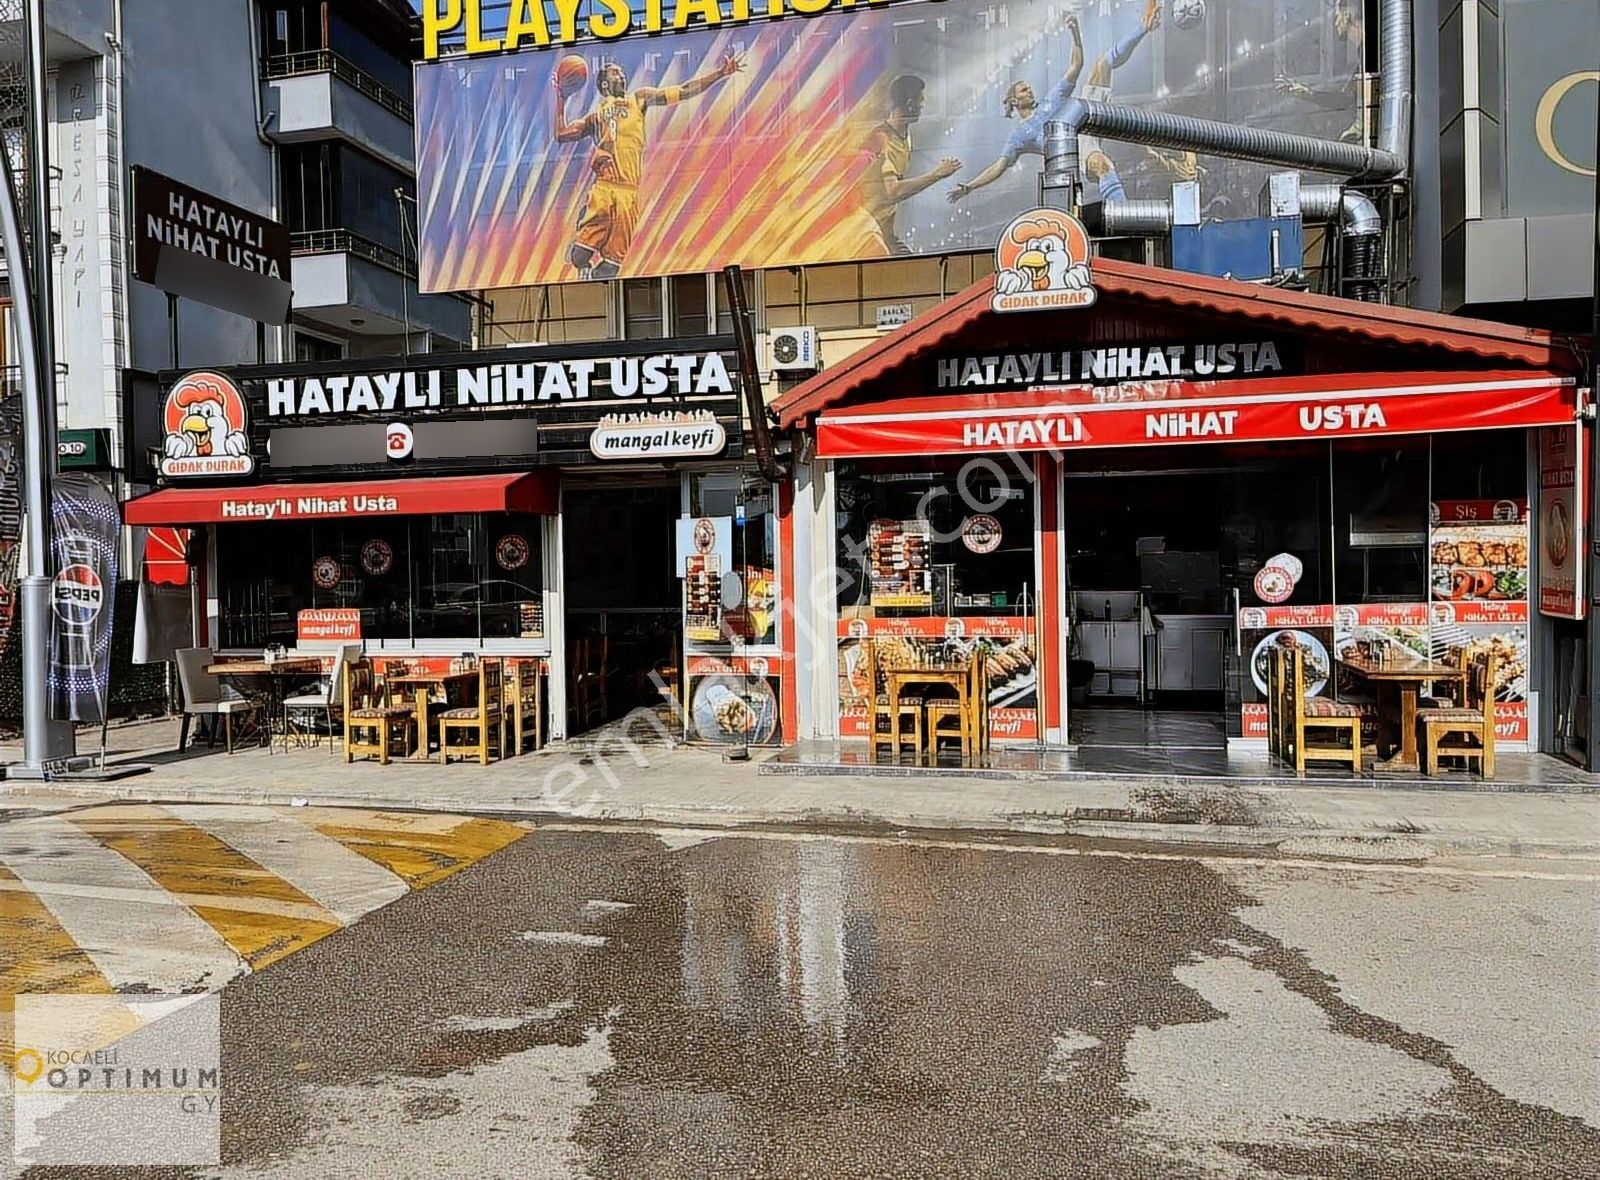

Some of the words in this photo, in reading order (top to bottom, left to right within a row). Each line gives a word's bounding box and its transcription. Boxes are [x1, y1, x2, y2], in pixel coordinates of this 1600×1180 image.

[169, 192, 263, 248] HATAYLI
[227, 243, 281, 280] USTA
[1000, 296, 1039, 308] GIDAK
[1042, 292, 1087, 306] DURAK
[937, 350, 1071, 388] HATAYLI
[1193, 340, 1283, 375] USTA
[267, 370, 440, 416] HATAYLI
[609, 352, 732, 397] USTA
[605, 429, 669, 452] mangal
[672, 427, 714, 450] keyfi
[962, 416, 1082, 447] HATAYLI
[1300, 403, 1387, 431] USTA
[168, 461, 203, 474] GIDAK
[206, 459, 245, 472] DURAK
[297, 497, 347, 514] Nihat
[353, 495, 398, 512] Usta
[993, 719, 1021, 735] keyfi
